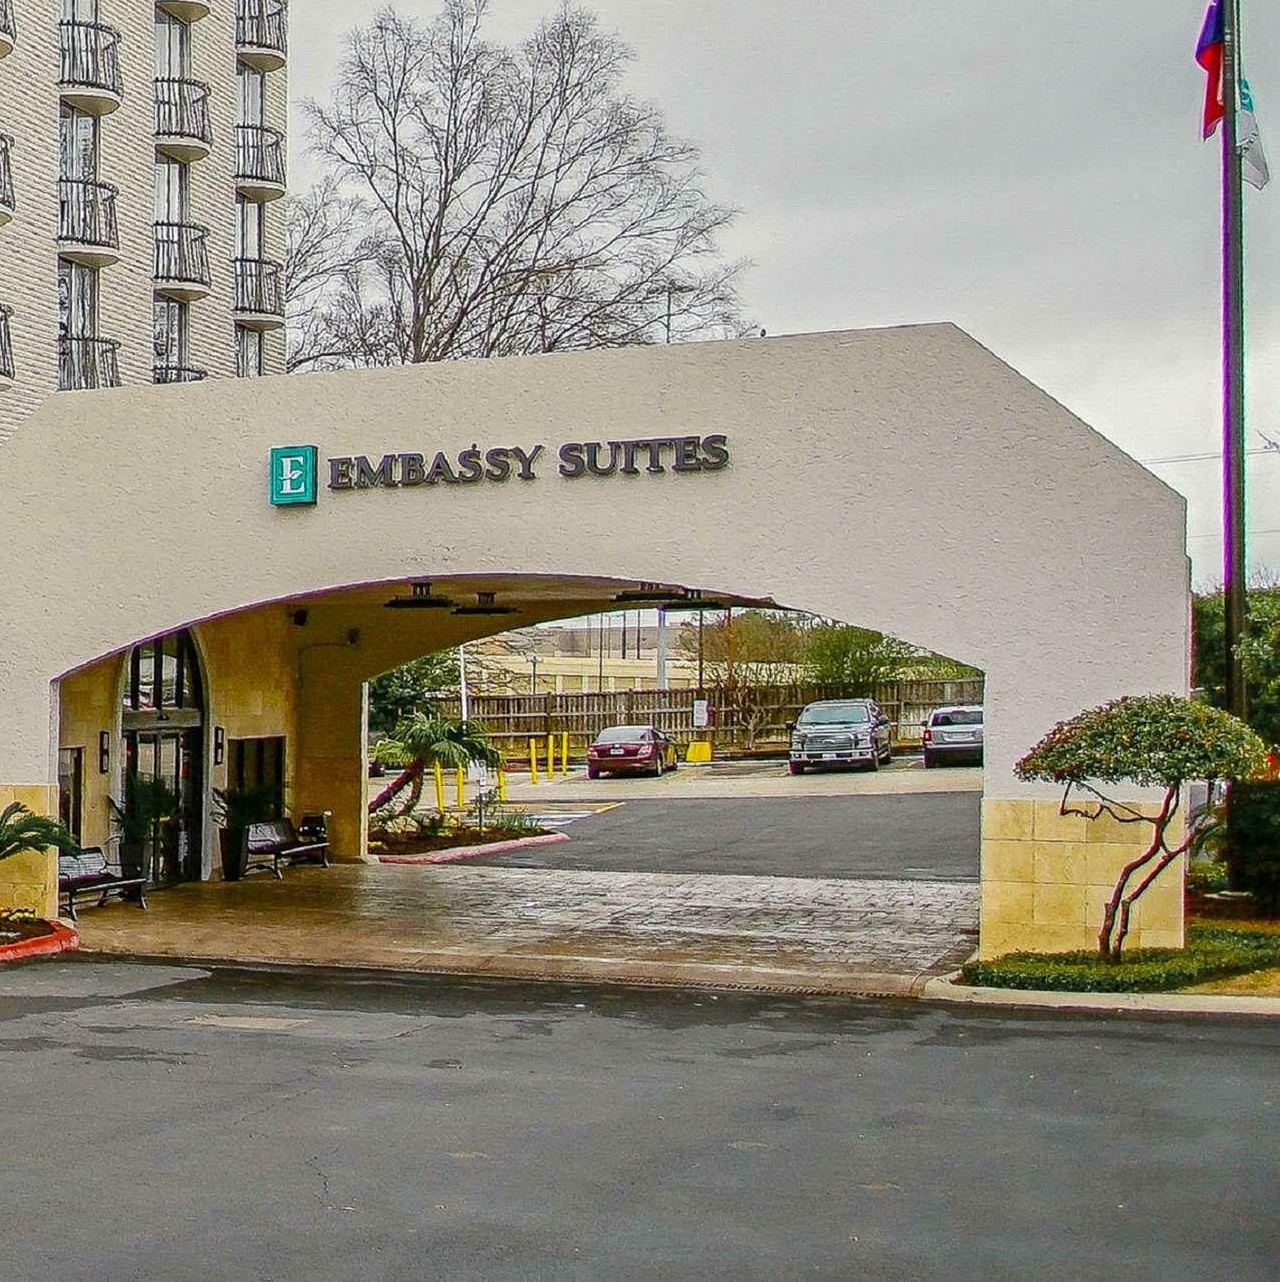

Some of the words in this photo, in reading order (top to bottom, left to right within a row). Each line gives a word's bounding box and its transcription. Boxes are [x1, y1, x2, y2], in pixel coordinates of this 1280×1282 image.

[278, 455, 305, 494] E
[327, 444, 544, 490] EMBASSY
[558, 435, 730, 478] SUITES
